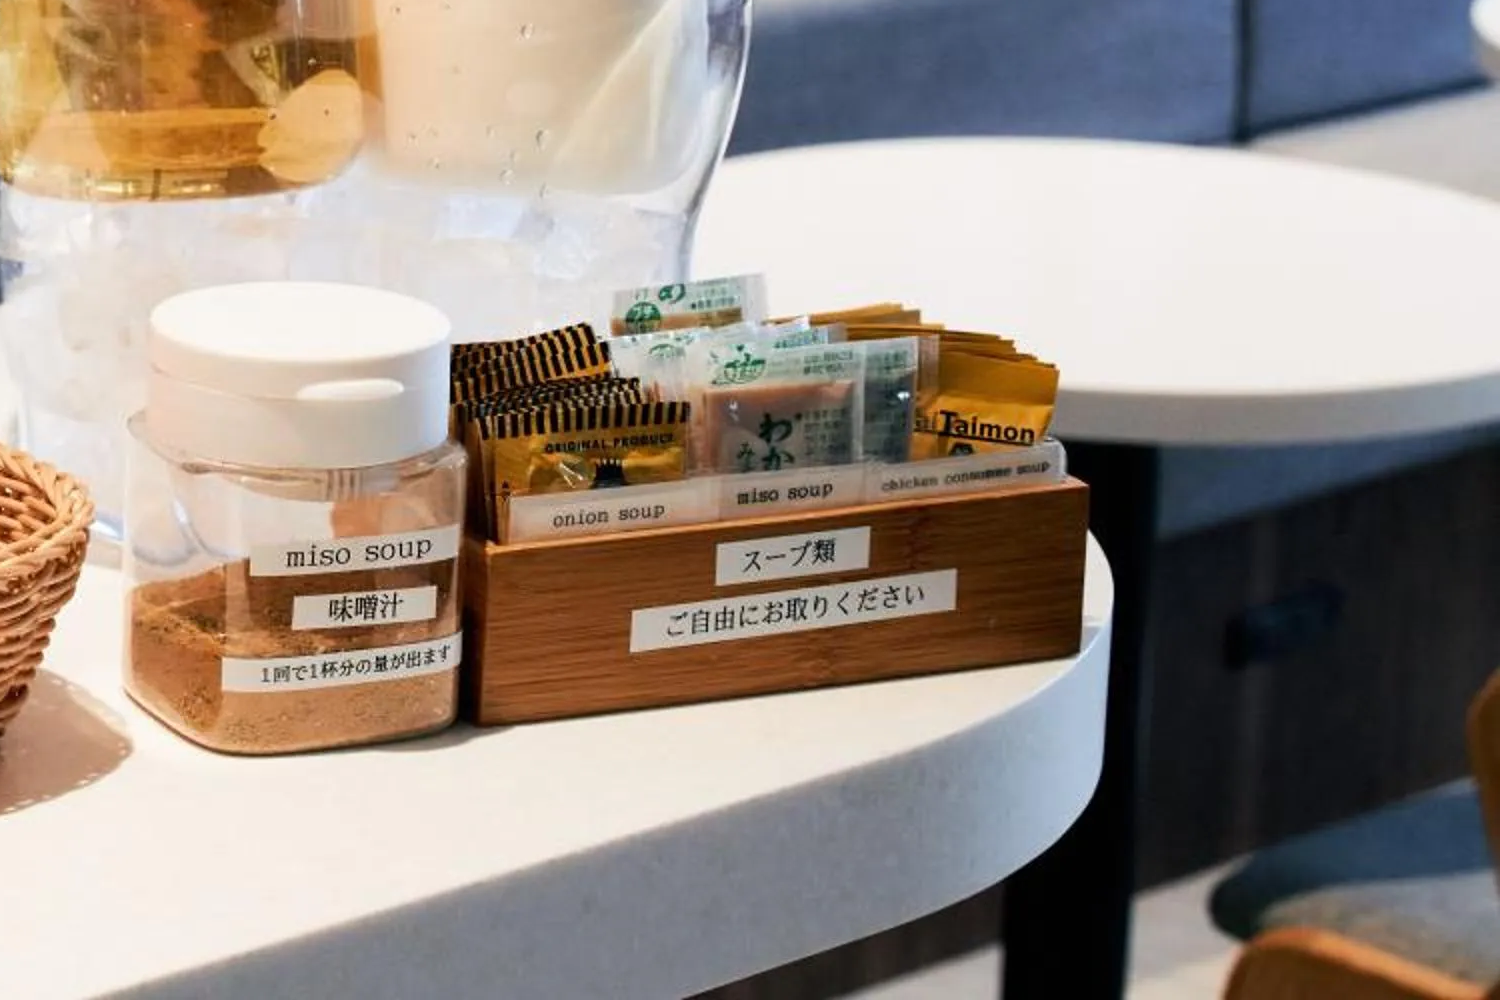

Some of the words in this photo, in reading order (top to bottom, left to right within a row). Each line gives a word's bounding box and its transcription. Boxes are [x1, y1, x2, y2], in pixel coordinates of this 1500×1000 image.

[939, 409, 1035, 444] Taimon
[881, 476, 938, 492] chicken
[1017, 460, 1050, 476] soup
[737, 488, 779, 505] miso
[787, 482, 833, 499] soup
[553, 509, 609, 528] onion
[618, 504, 665, 521] soup
[286, 544, 351, 568] miso
[364, 538, 432, 562] soup
[742, 537, 836, 573] スープ類
[329, 592, 404, 623] 味噌汁
[666, 583, 925, 637] ご自由にお取りください
[261, 645, 451, 683] 1回で1杯分の量が出ます
